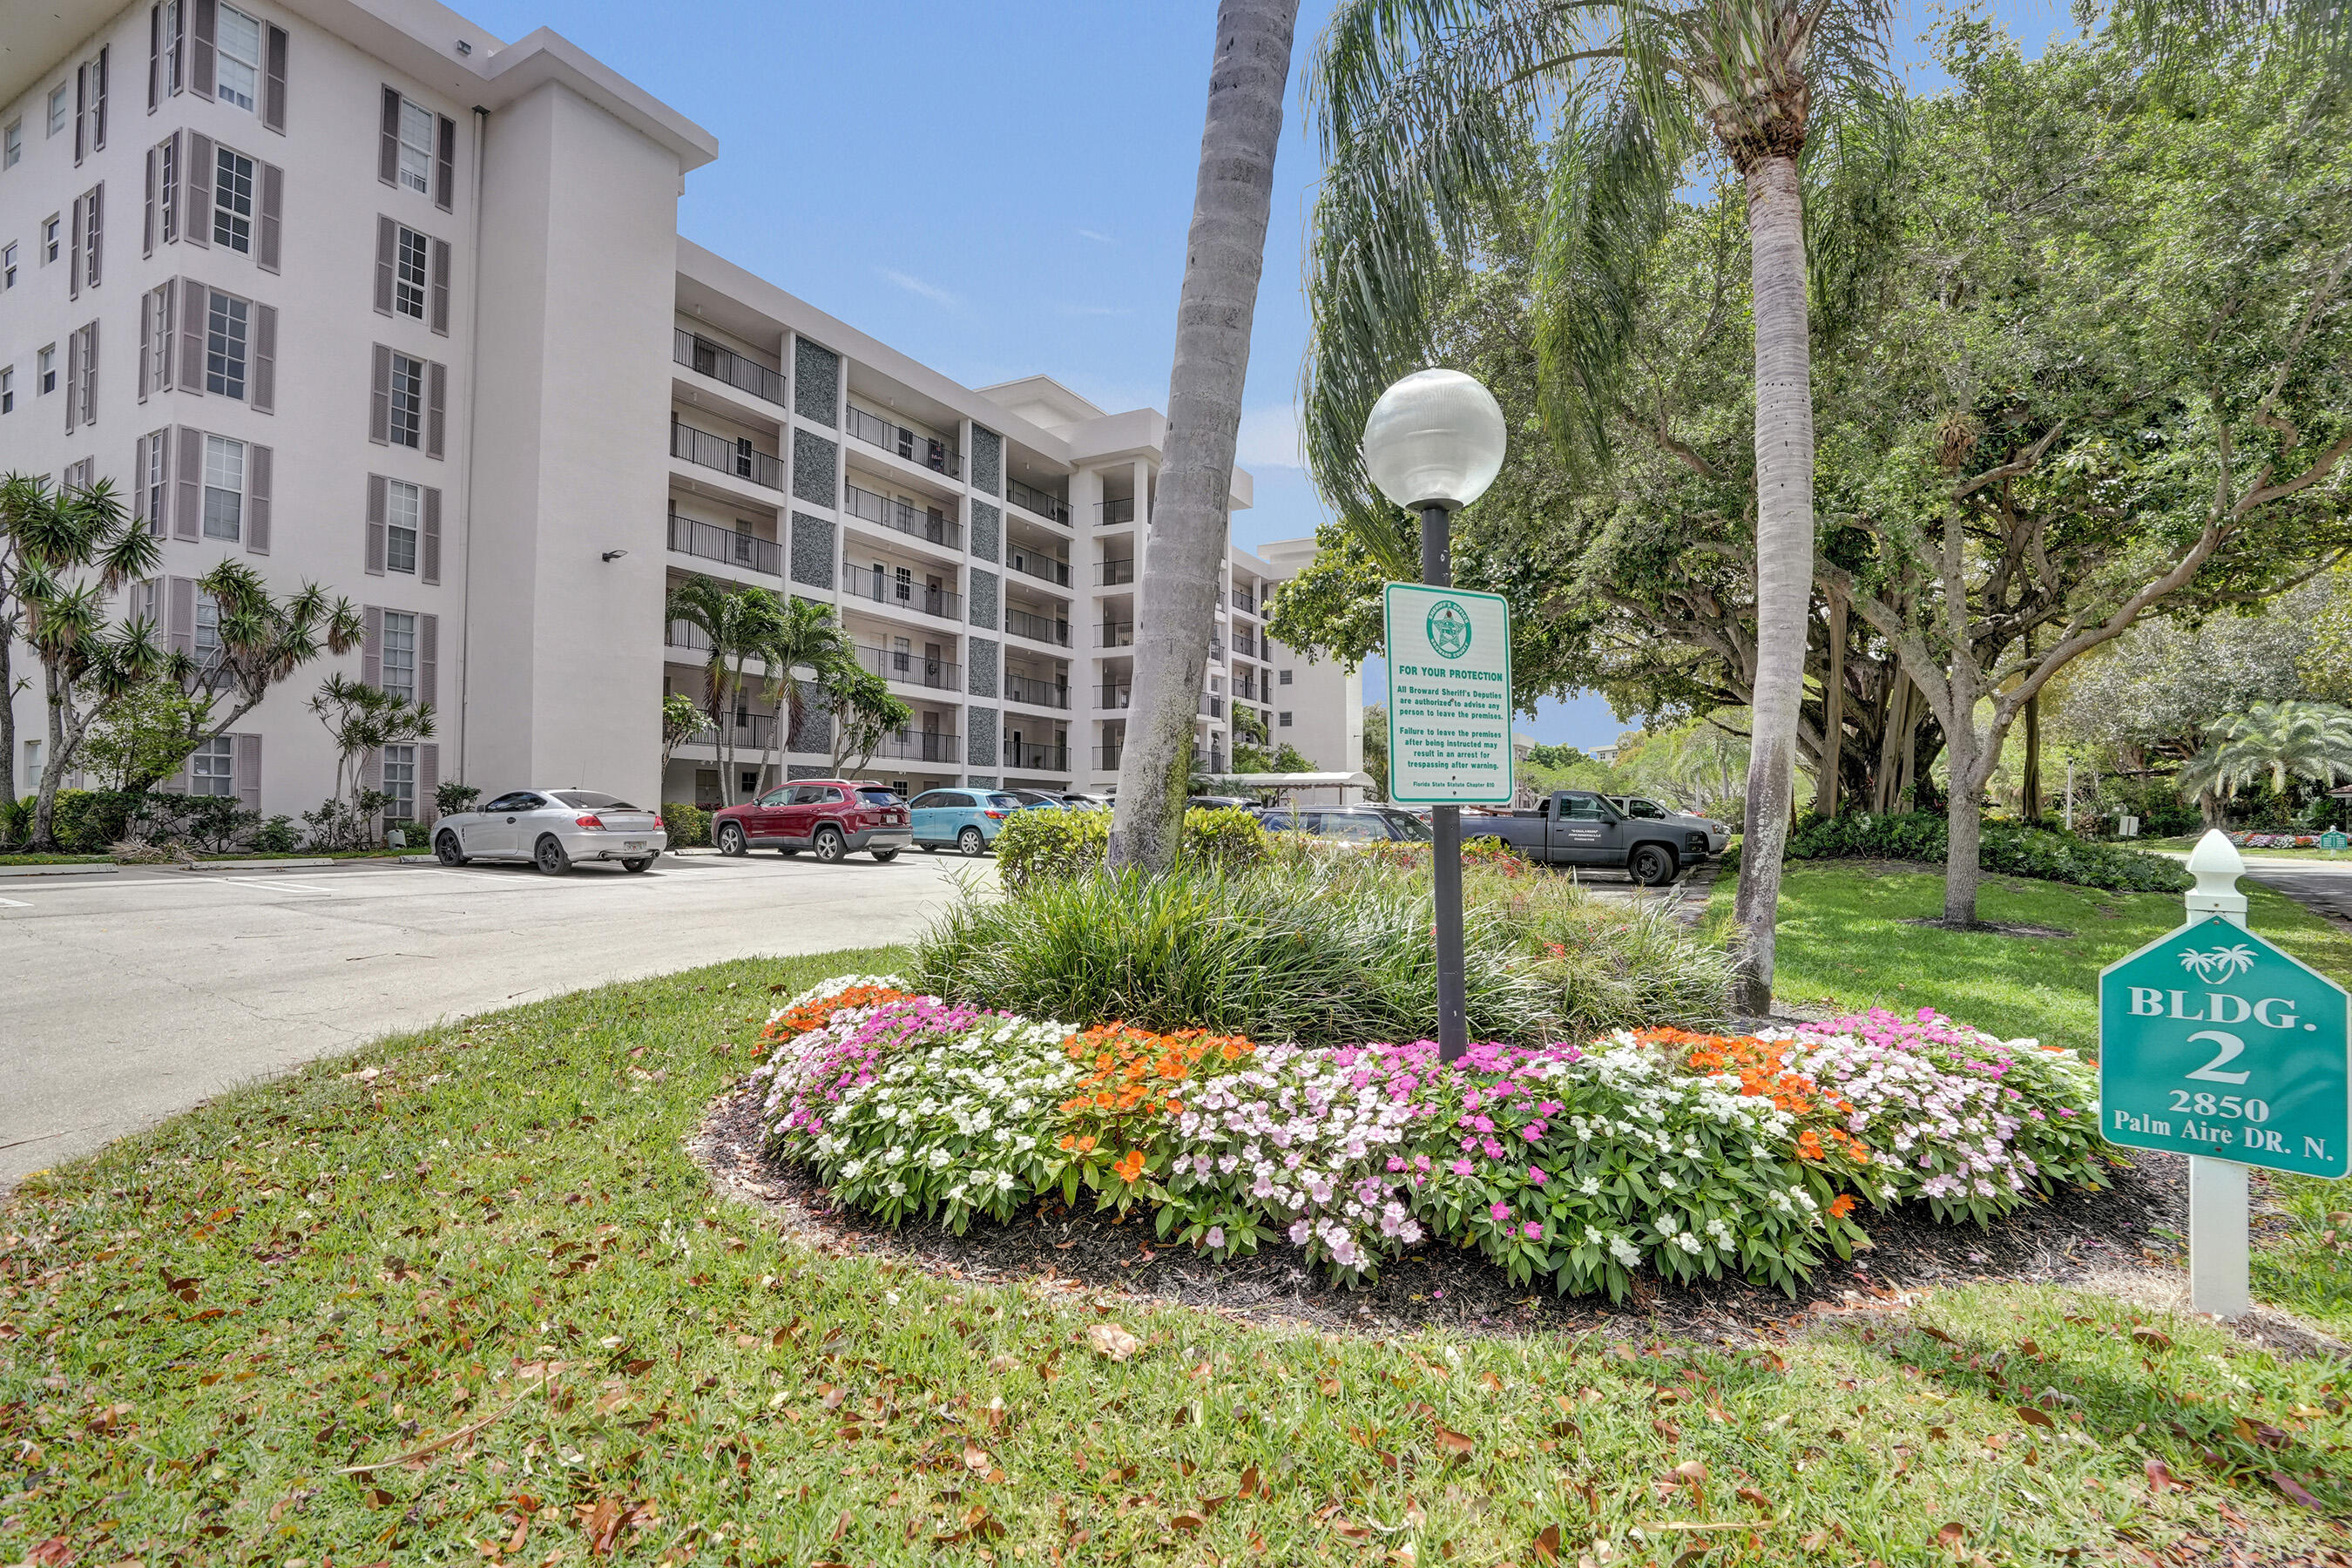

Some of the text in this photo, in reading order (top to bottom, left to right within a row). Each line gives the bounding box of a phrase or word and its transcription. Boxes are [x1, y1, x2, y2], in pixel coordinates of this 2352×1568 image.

[1399, 666, 1503, 681] FOR YOUR PROTECTION
[1409, 686, 1439, 695] Broward
[1473, 691, 1502, 700] Deputies
[1408, 760, 1449, 769] trespassing
[2127, 986, 2316, 1031] BLDG.
[2185, 1030, 2251, 1085] 2
[2169, 1089, 2269, 1122] 2850
[2113, 1110, 2334, 1161] Palm Aire DR. N.
